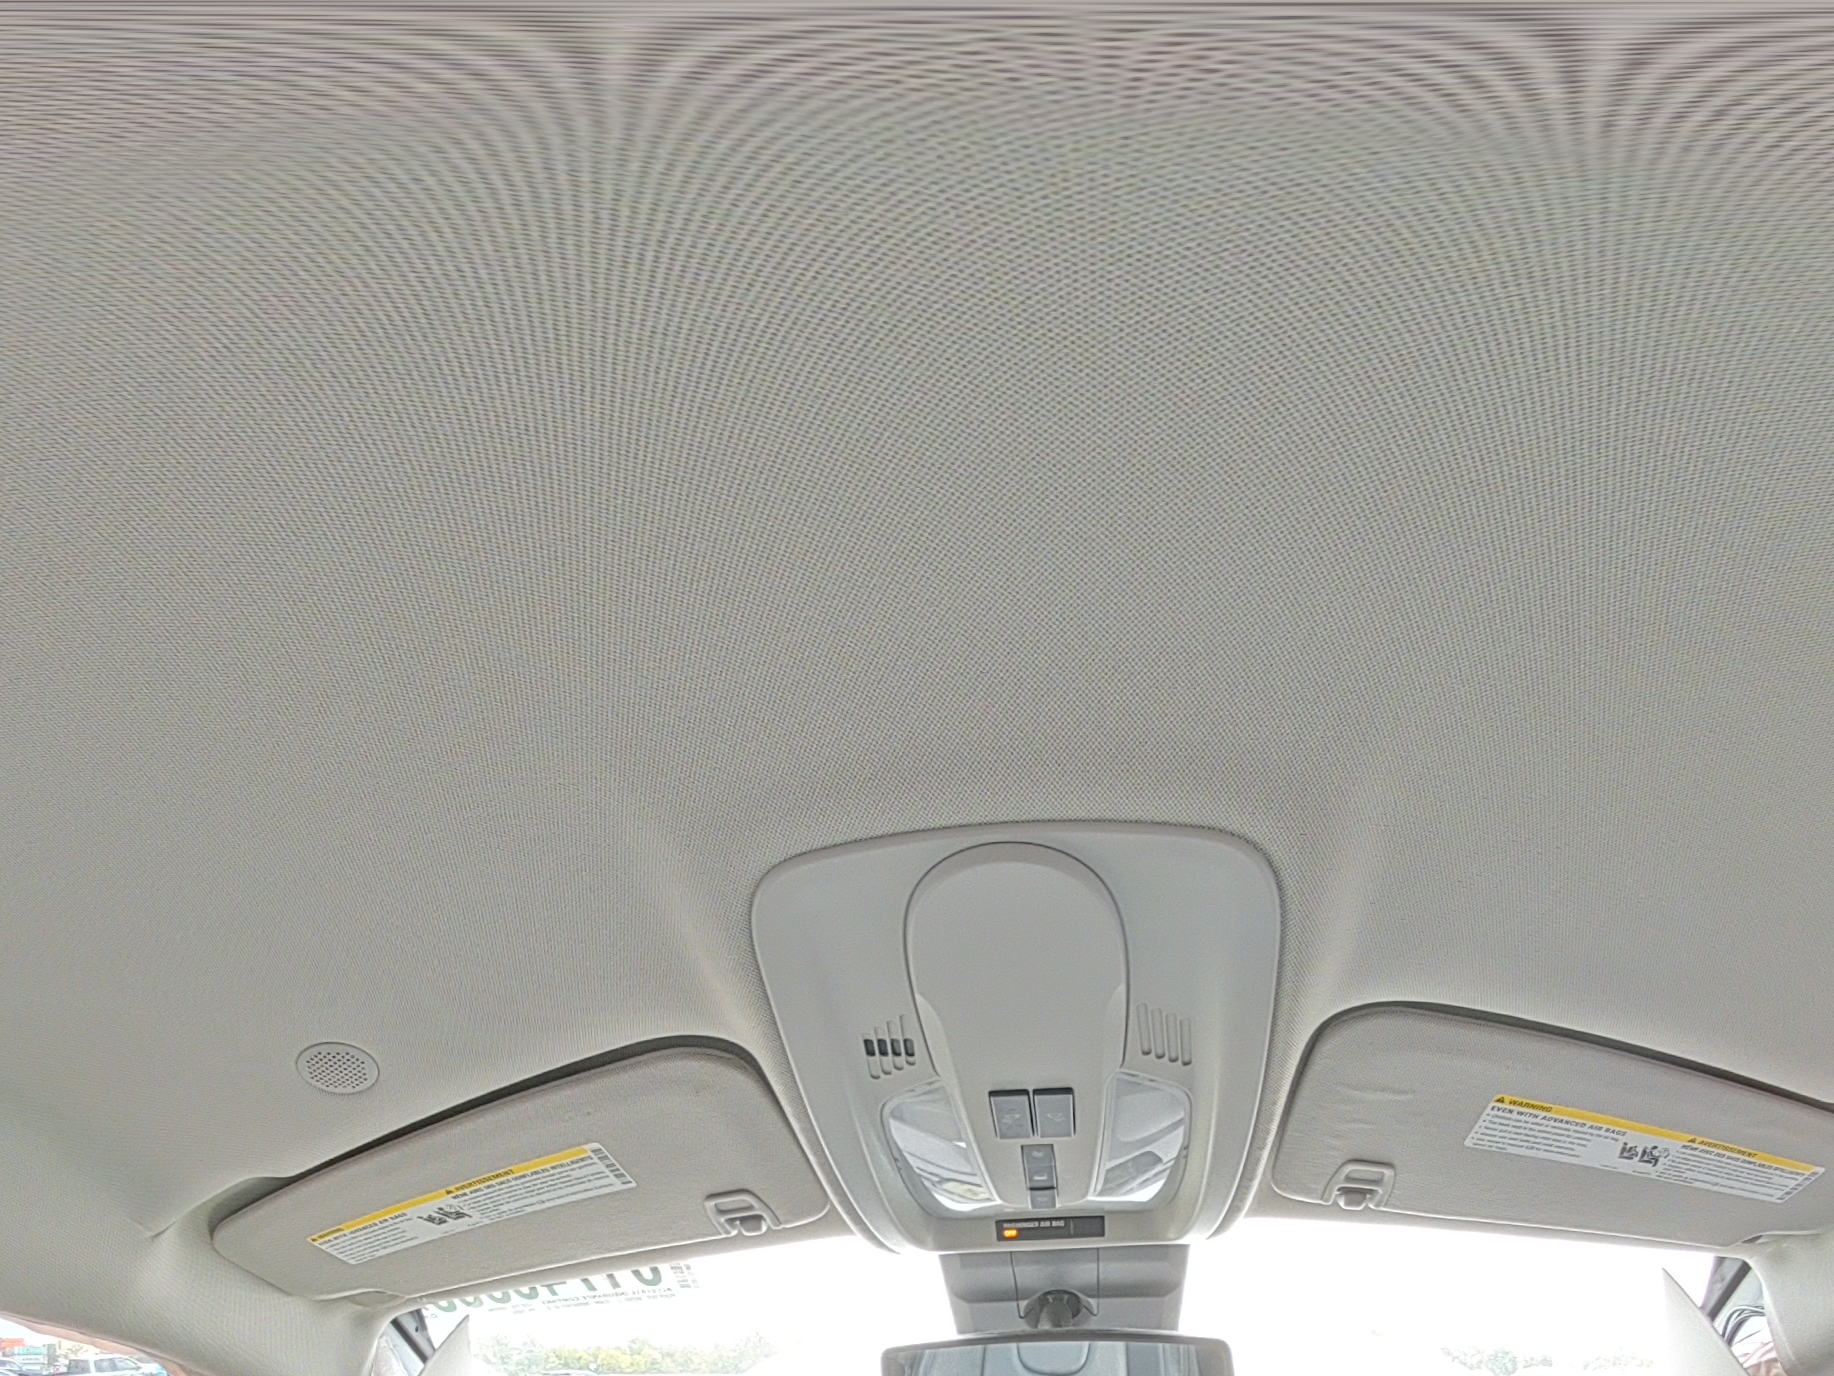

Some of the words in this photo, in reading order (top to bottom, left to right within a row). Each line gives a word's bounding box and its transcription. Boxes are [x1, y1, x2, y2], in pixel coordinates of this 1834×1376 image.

[1509, 1100, 1553, 1113] WARNING
[1490, 1105, 1515, 1115] EVEN
[1517, 1110, 1539, 1120] WITH
[1541, 1115, 1587, 1128] ADVANCED
[1588, 1124, 1603, 1132] AIR
[1604, 1127, 1628, 1137] BAGS
[454, 1168, 515, 1191] AVERTISSEMENT
